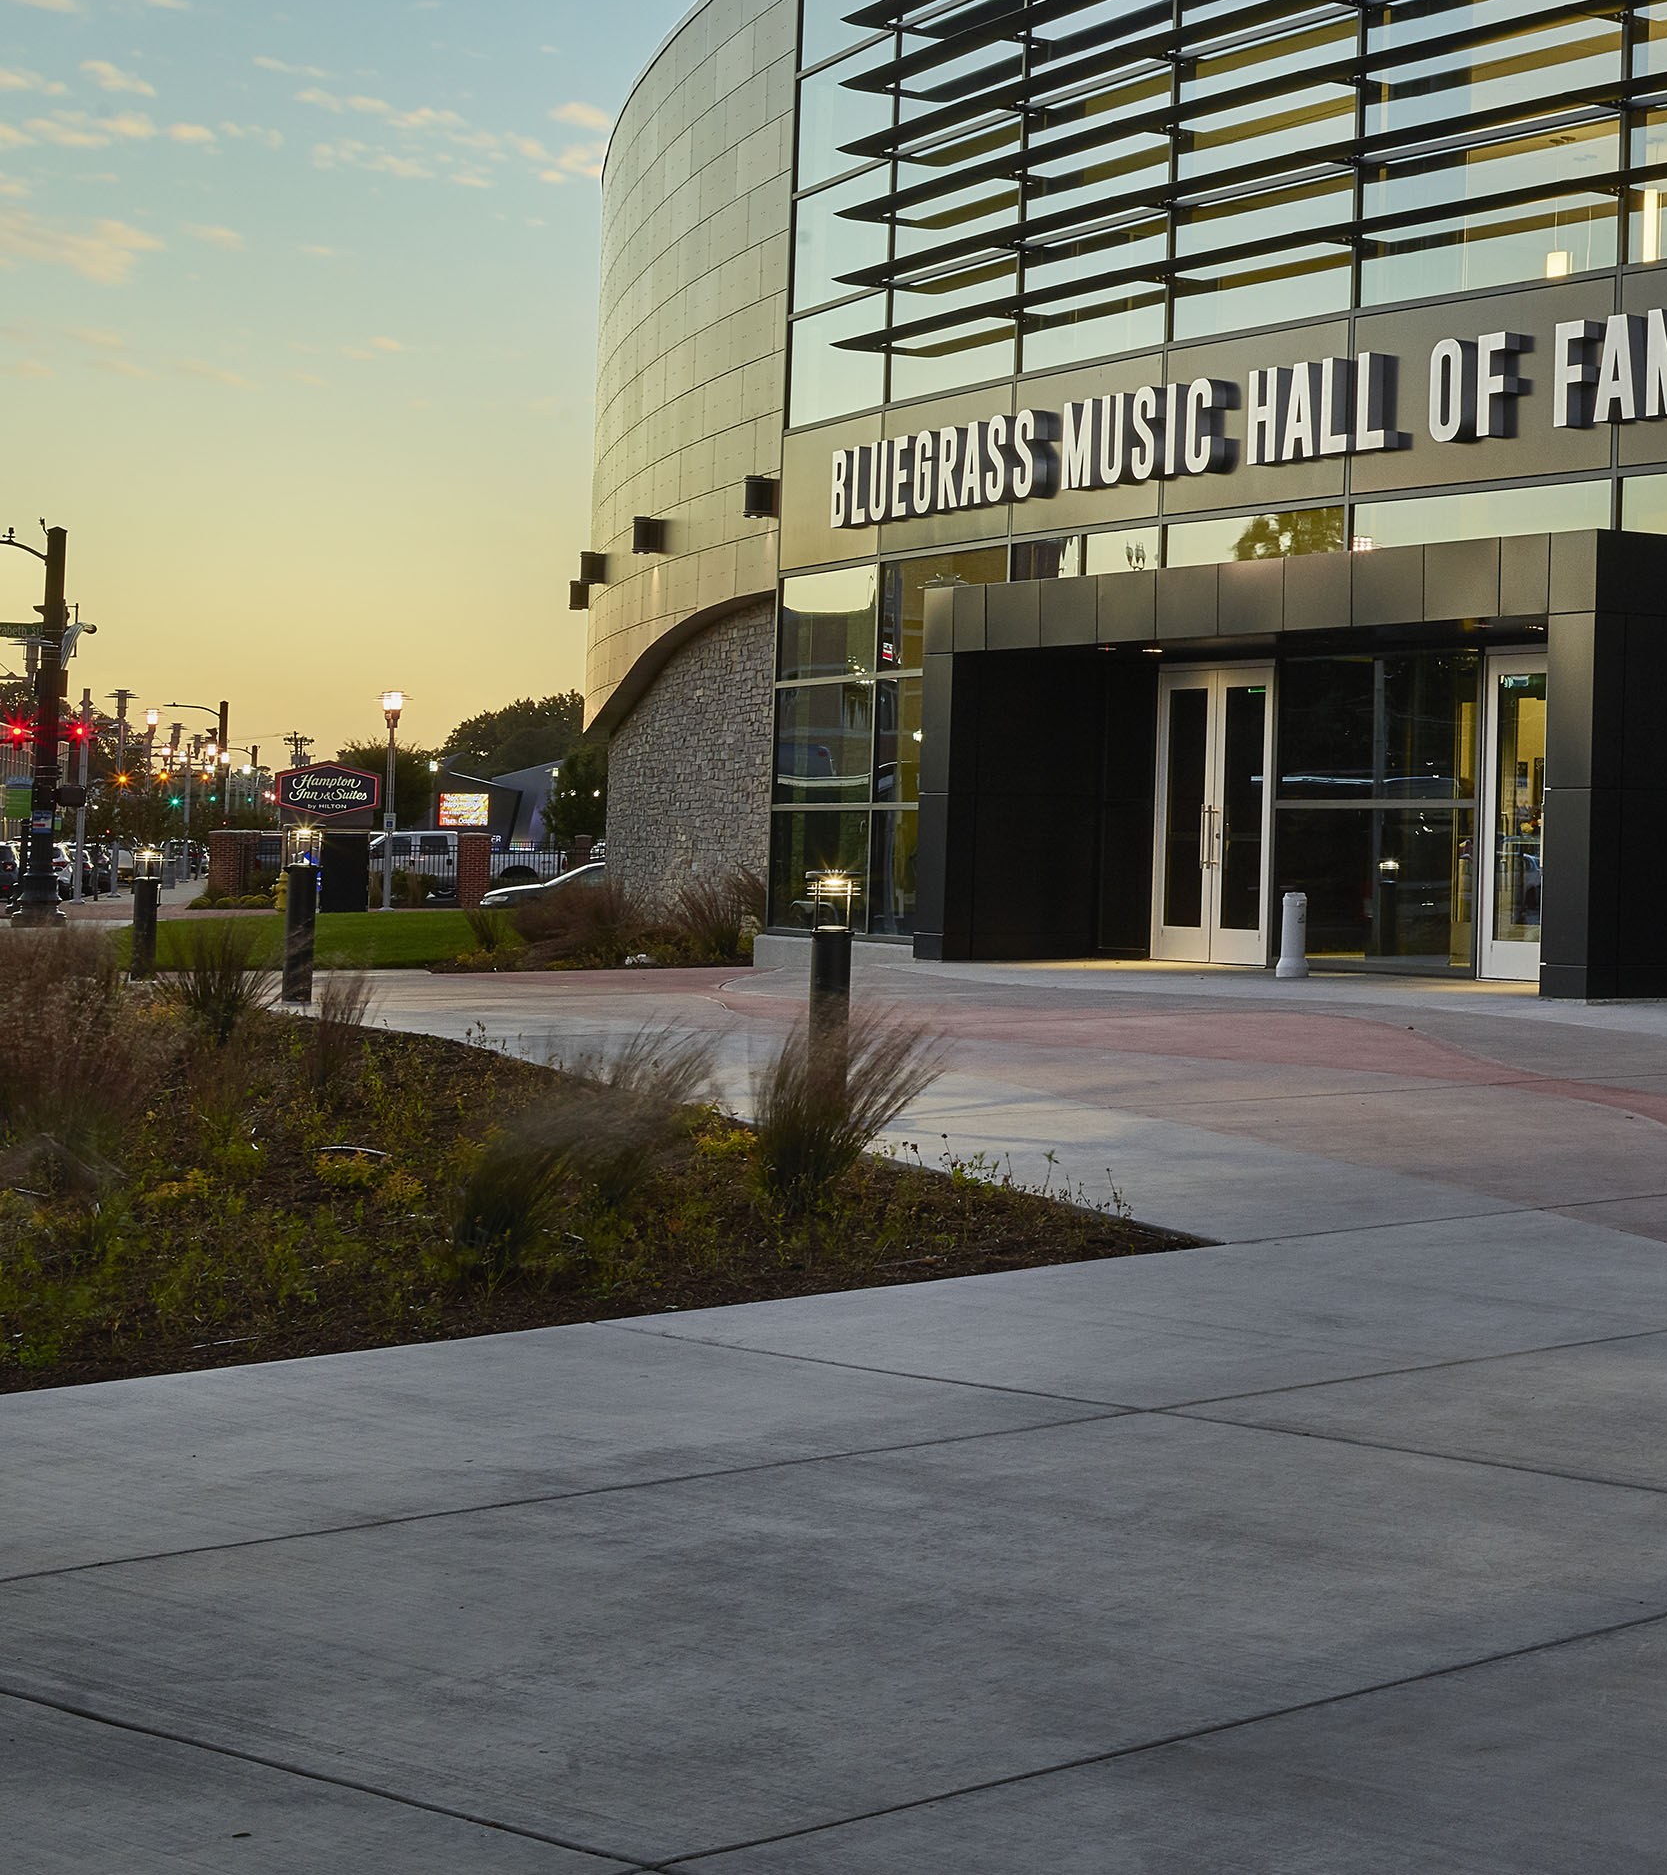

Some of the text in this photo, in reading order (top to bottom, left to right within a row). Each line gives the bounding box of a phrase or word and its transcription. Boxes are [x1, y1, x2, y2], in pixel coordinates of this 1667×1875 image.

[830, 408, 1037, 528] BLUEGRASS
[1060, 377, 1215, 491] MUSIC
[1246, 351, 1388, 465] HALL
[1428, 330, 1510, 443] OF
[292, 773, 362, 789] Hampton
[288, 788, 368, 801] Inn & Suites
